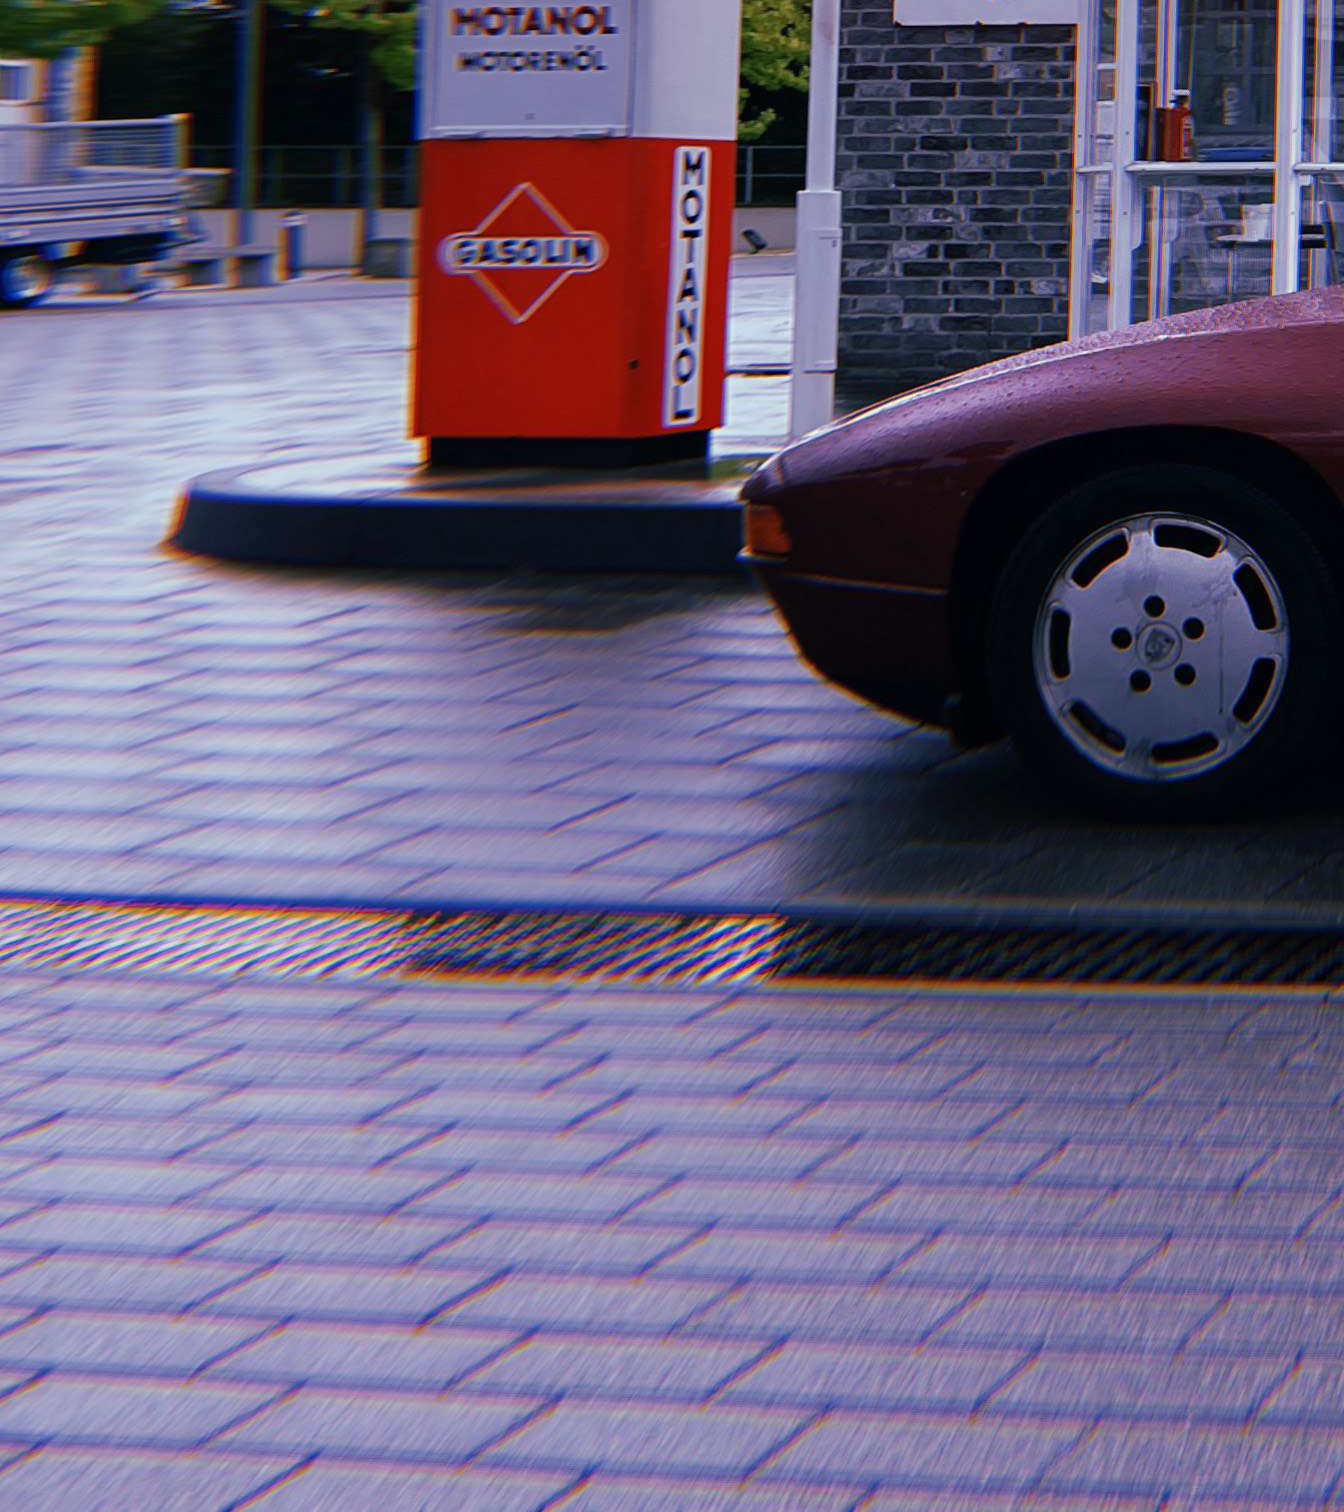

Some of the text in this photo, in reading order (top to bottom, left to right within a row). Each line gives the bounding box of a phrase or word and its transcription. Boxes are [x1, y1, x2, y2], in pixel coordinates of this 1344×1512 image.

[449, 6, 618, 35] MOTANOL
[455, 45, 607, 72] MOTORENÖL
[453, 236, 594, 265] GASOLIN
[672, 150, 705, 421] MOTANOL
